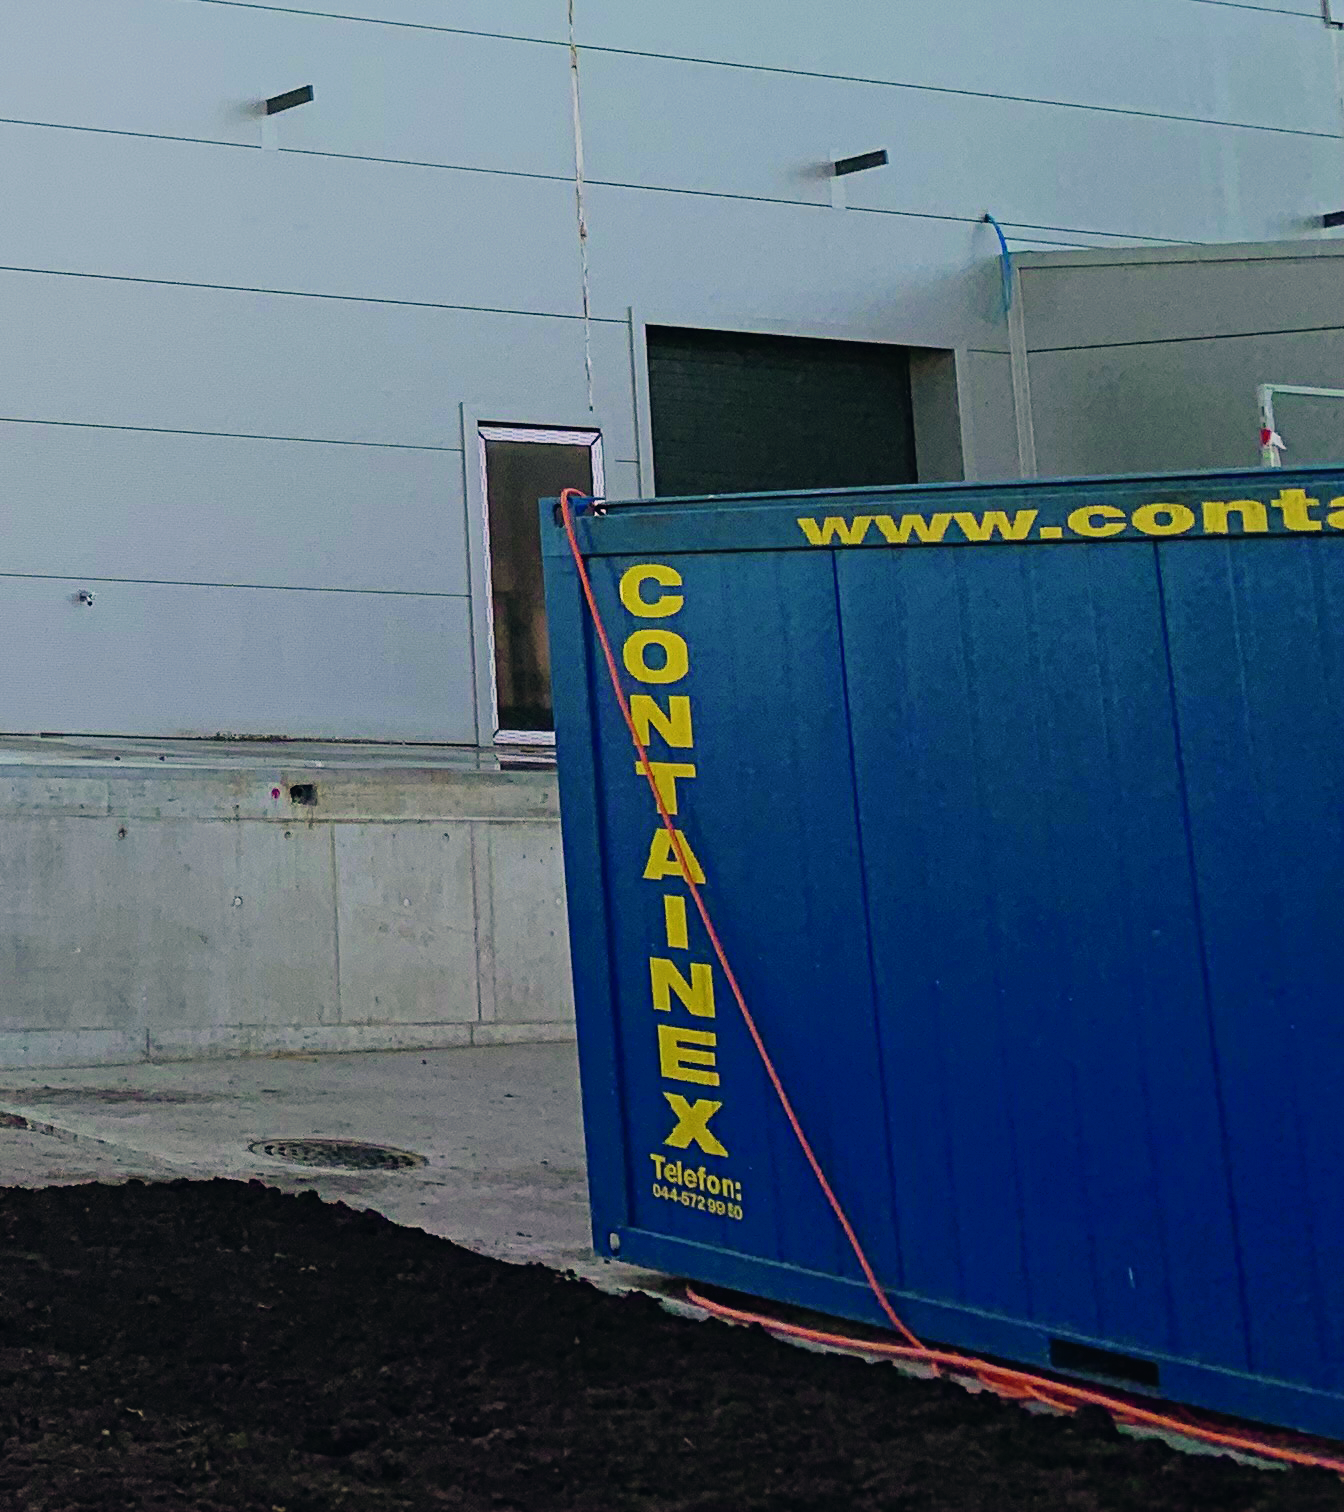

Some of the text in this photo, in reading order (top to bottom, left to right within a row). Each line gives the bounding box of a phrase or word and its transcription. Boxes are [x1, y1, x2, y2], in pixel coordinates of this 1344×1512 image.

[797, 488, 1344, 544] www.cont
[618, 562, 729, 1157] CONTAINEX
[650, 1153, 742, 1201] Telefon:
